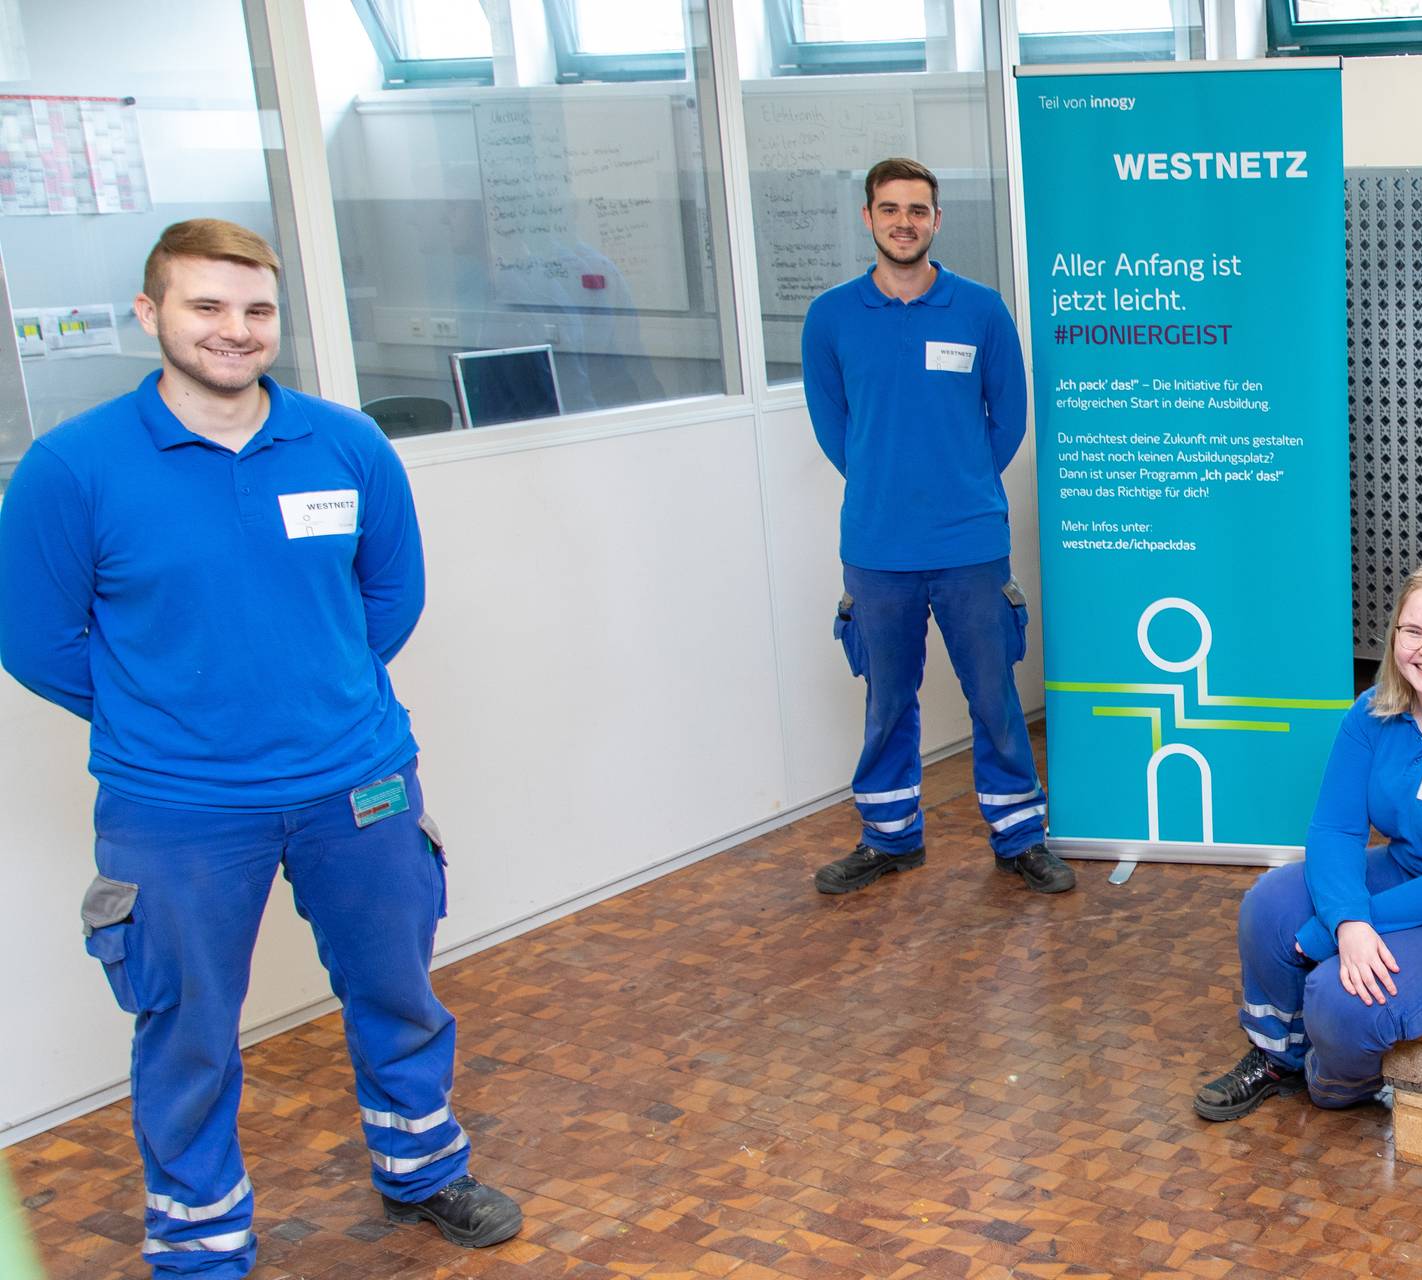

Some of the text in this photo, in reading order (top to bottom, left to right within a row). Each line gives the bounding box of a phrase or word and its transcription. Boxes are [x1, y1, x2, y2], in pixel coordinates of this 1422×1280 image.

[1039, 96, 1135, 110] Teil von innogy
[1114, 151, 1308, 180] WESTNETZ
[1052, 253, 1241, 281] Aller Anfang ist
[1051, 288, 1186, 316] jetzt leicht.
[1054, 325, 1232, 345] #PIONIERGEIST
[1153, 379, 1171, 390] Die
[1174, 380, 1220, 391] Initiative
[1223, 380, 1238, 391] für
[1242, 380, 1262, 392] den
[1056, 397, 1270, 412] erfolgreichen Start in deine Ausbildung.
[1058, 432, 1303, 448] Du möchtest deine Zukunft mit uns gestalten
[1058, 451, 1274, 465] und hast noch keinen Ausbildungsplatz?
[1060, 468, 1087, 480] Dann
[1090, 471, 1103, 480] ist
[1106, 472, 1136, 480] unser
[1140, 468, 1197, 482] Programm
[1060, 486, 1209, 500] genau das Richtige für dich!
[306, 501, 355, 511] WESTNETZ
[1062, 521, 1152, 532] Mehr Infos unter:
[1062, 539, 1196, 552] westnetz.de/ichpackdas
